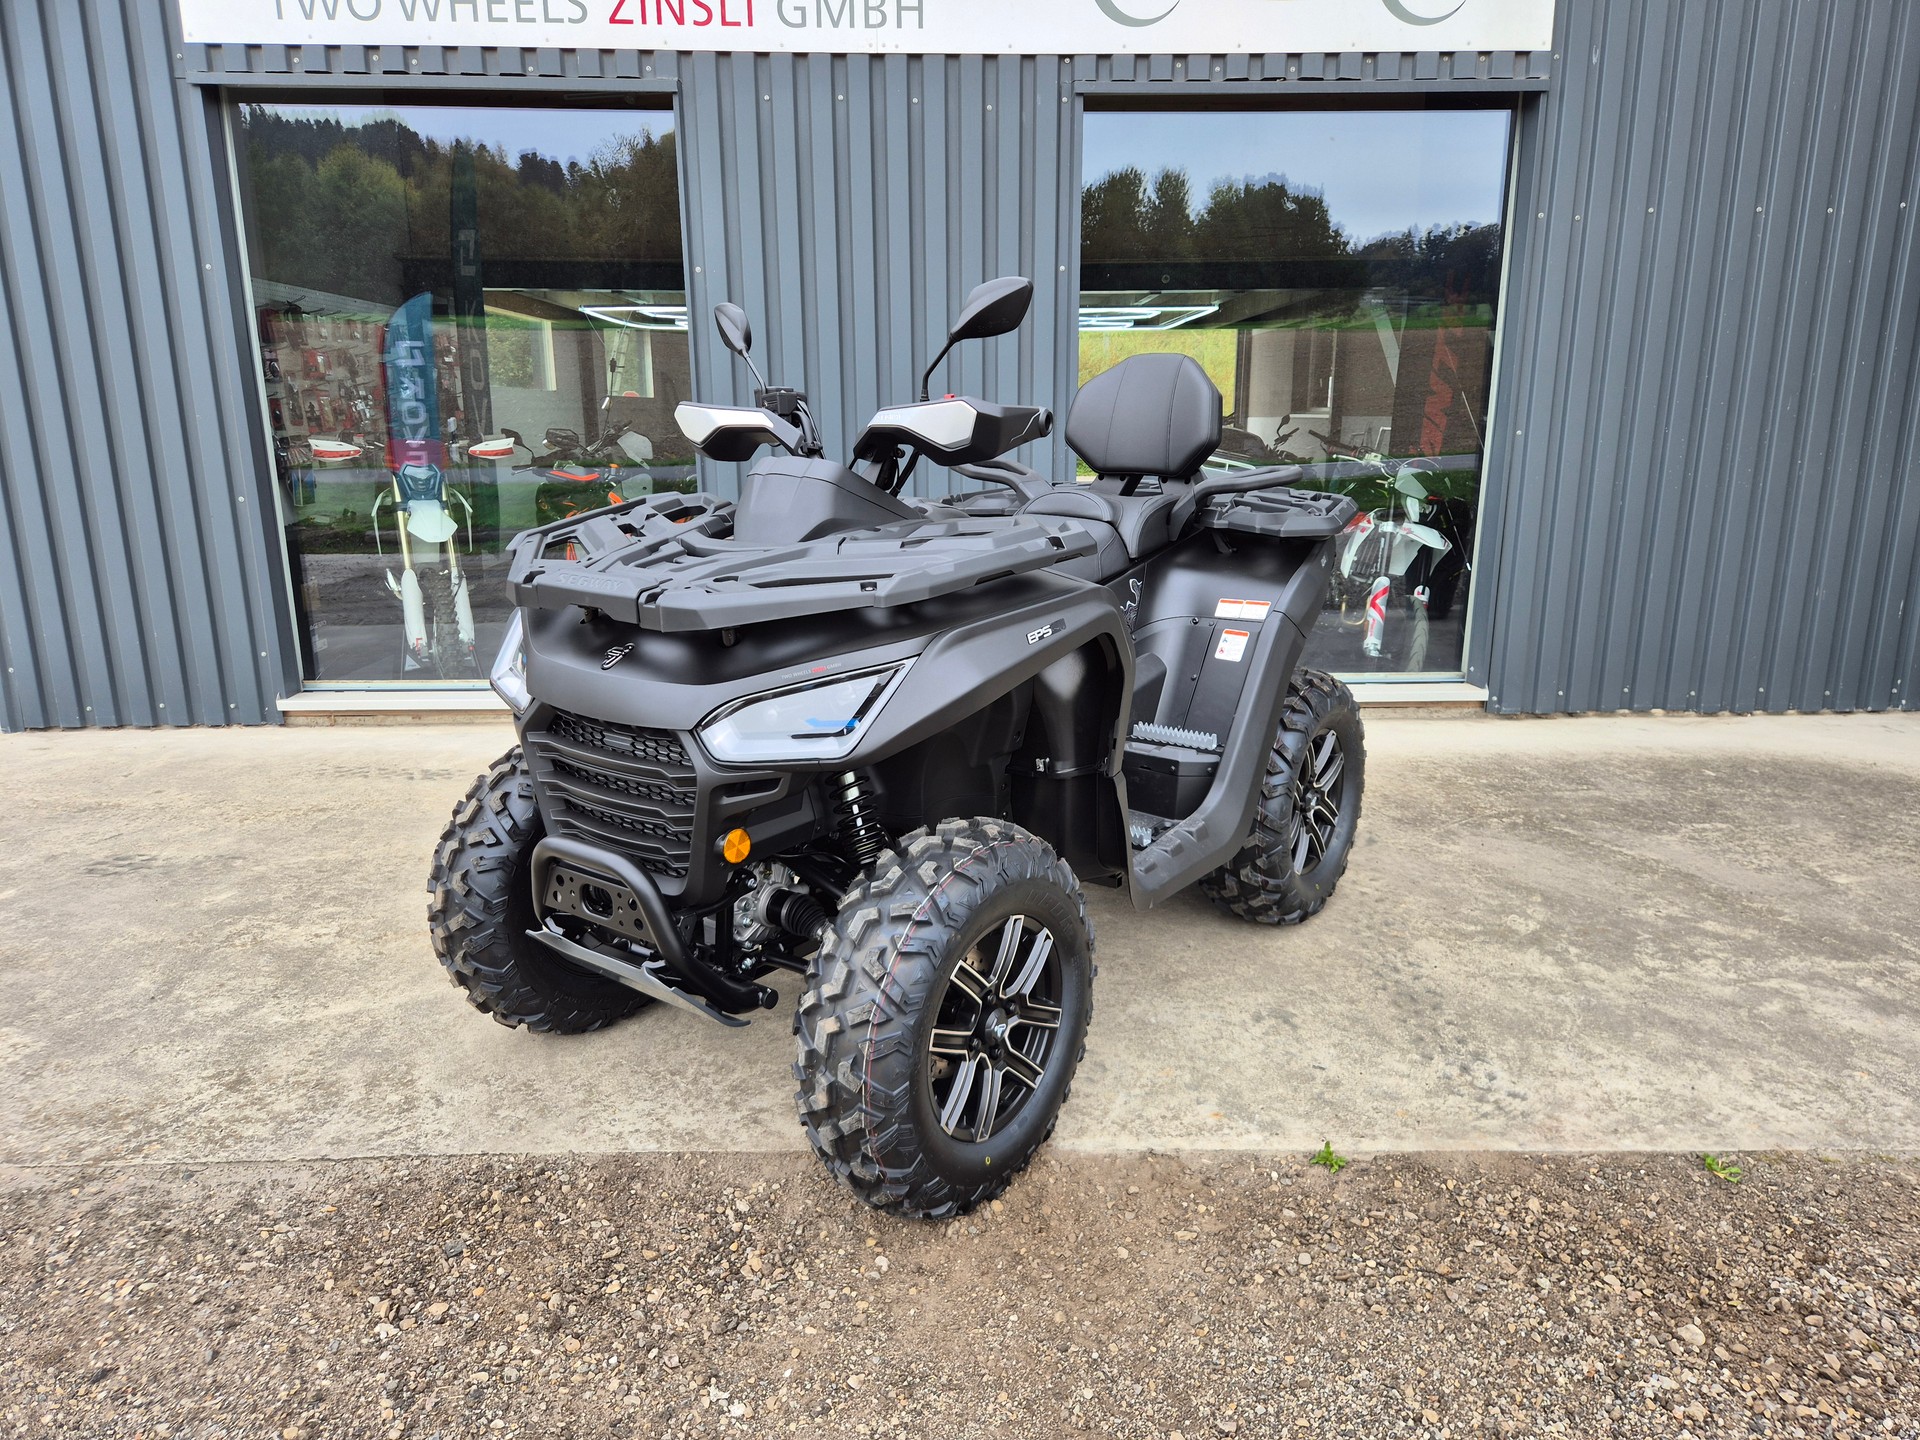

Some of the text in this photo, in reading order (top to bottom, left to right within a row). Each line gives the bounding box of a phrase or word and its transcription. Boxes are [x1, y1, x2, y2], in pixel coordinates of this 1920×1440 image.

[399, 0, 588, 24] WHEELS
[609, 0, 754, 27] ZINSLI
[777, 0, 923, 29] GMBH
[556, 572, 623, 589] SEGWAY
[1026, 625, 1053, 645] EPS
